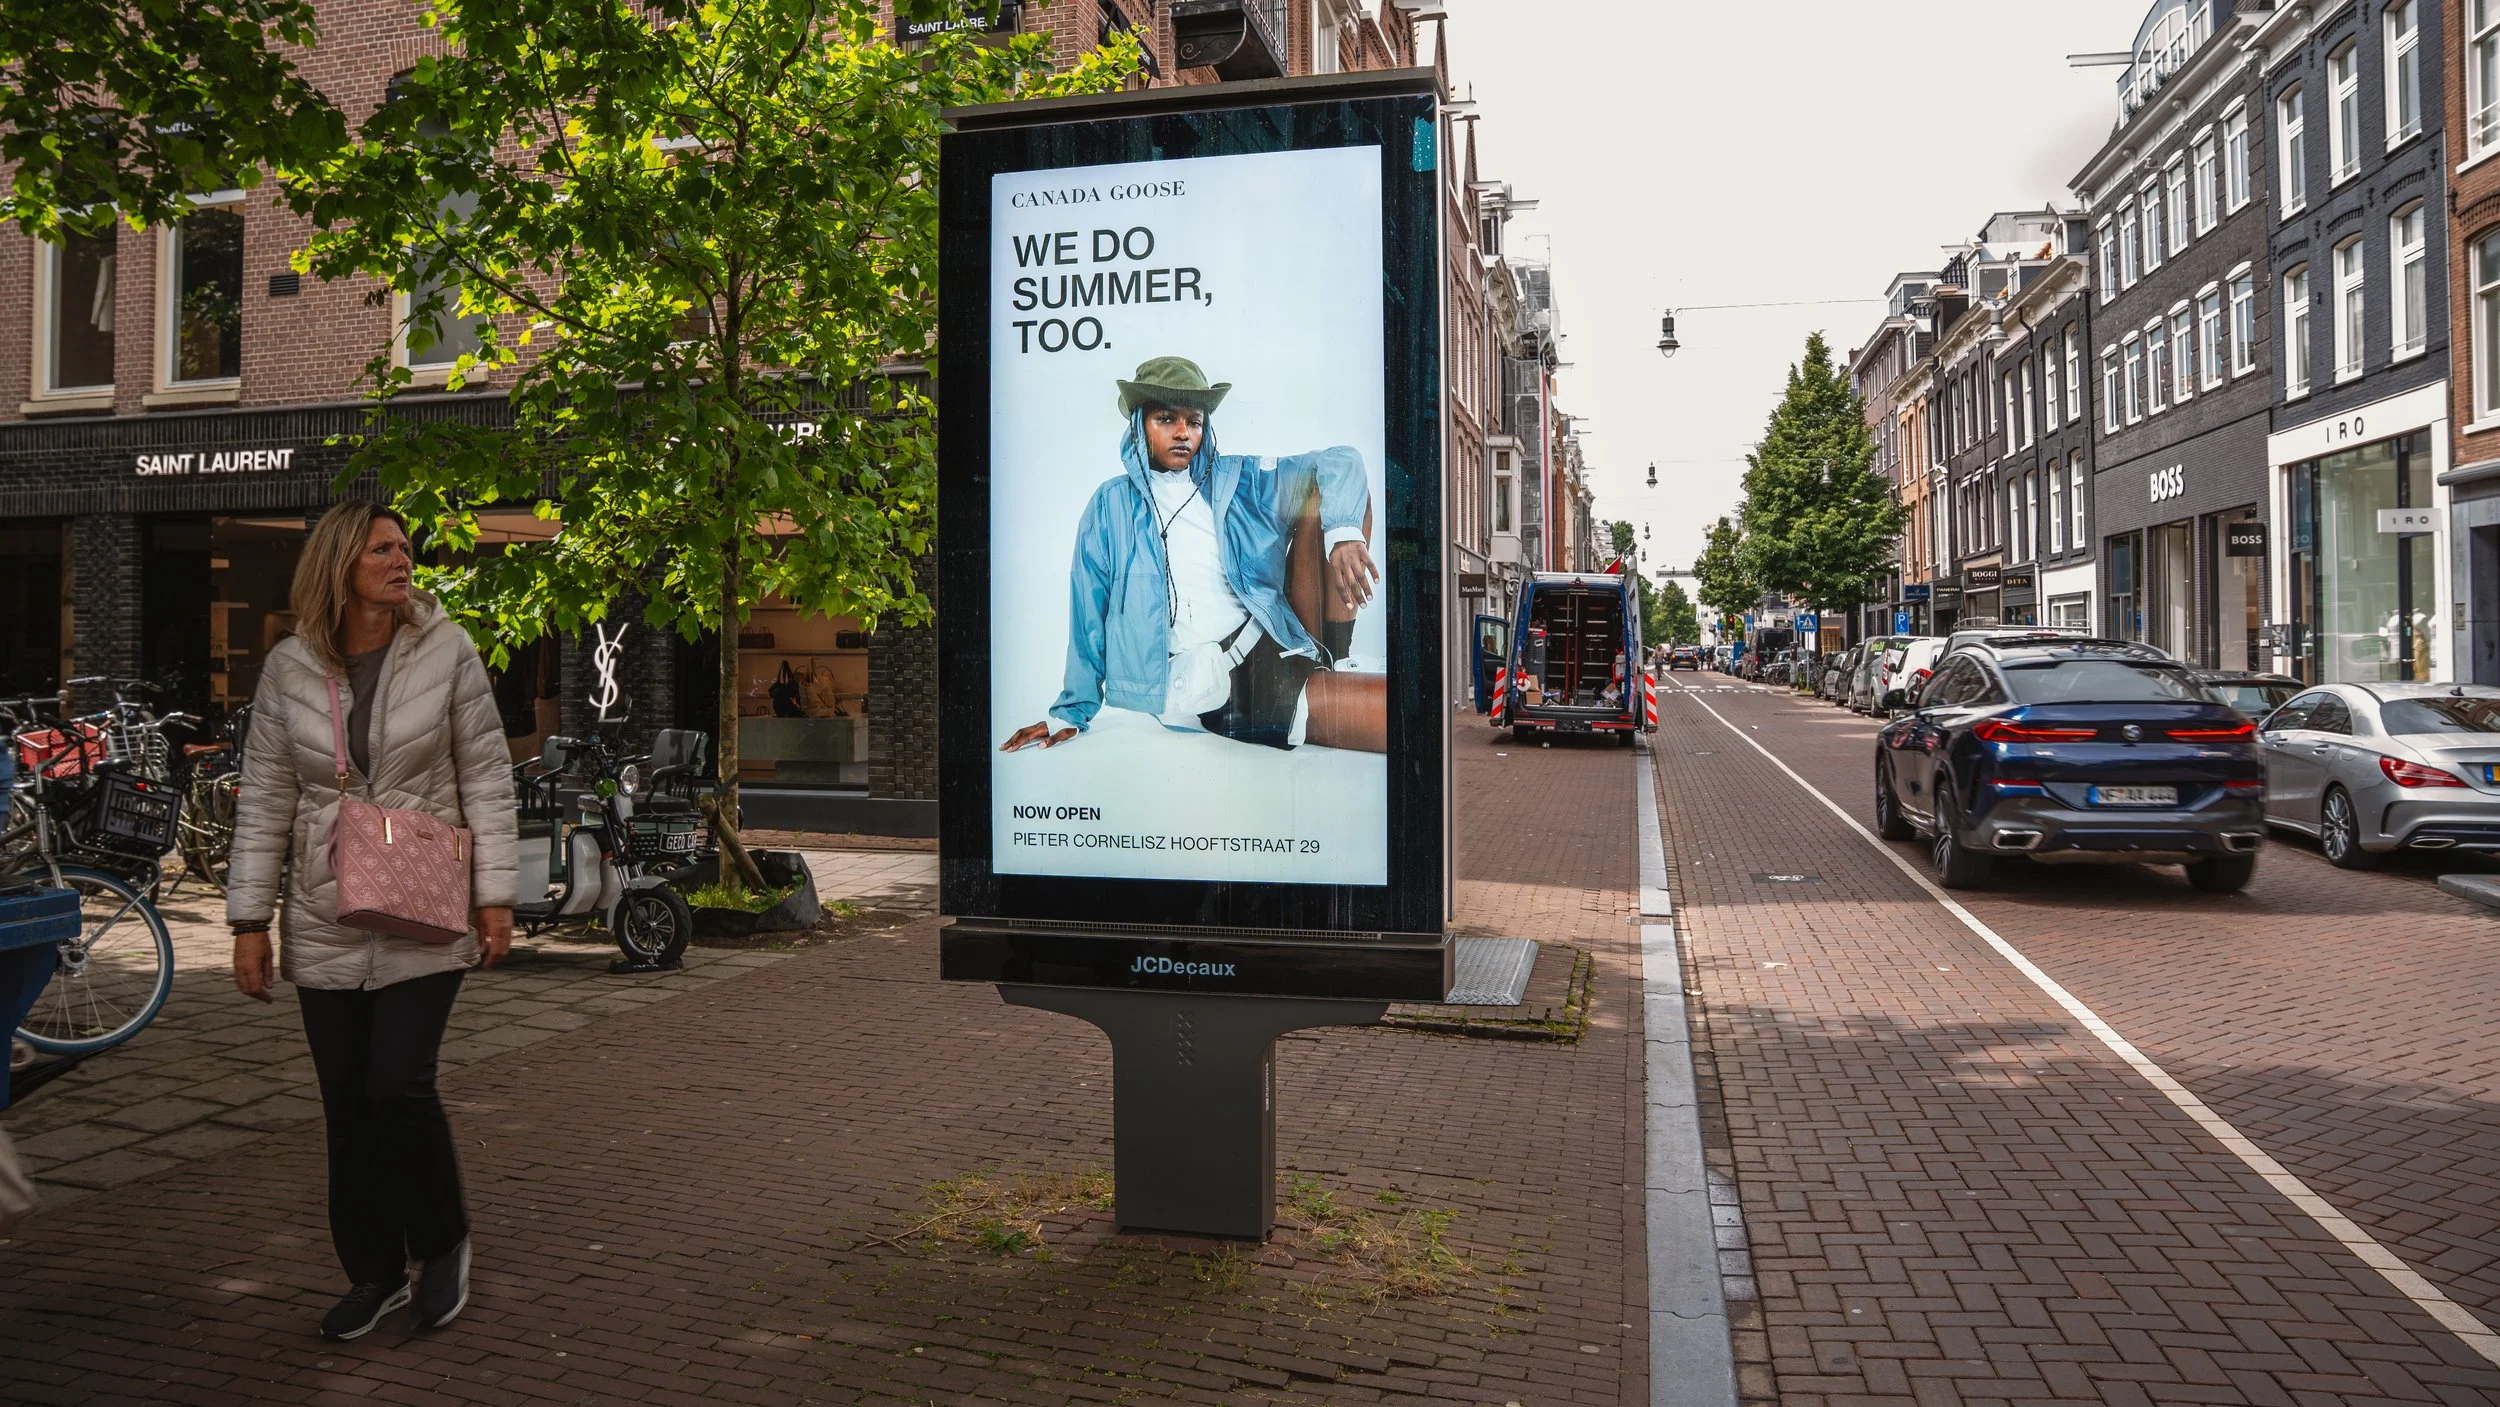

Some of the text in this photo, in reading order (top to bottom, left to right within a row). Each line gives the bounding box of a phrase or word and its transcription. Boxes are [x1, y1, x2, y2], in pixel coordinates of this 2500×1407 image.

[908, 15, 1000, 35] SAINT LAURET
[1011, 180, 1186, 209] CANADA GOOSE
[1012, 226, 1155, 268] WE DO
[1012, 267, 1213, 312] SUMMER,
[1012, 316, 1112, 354] TOO.
[2326, 416, 2365, 443] IRO
[135, 448, 295, 476] SAINT LAURENT
[2150, 464, 2185, 503] BOSS
[2391, 516, 2430, 525] IRO
[2231, 535, 2263, 545] BOSS
[1972, 570, 1998, 578] BOGGI
[1898, 615, 1906, 625] P
[1013, 805, 1101, 821] NOW OPEN
[1013, 832, 1320, 853] PIETER CORNELISZ HOOFTSTRAAT 29
[1130, 956, 1236, 976] JCDecaux
